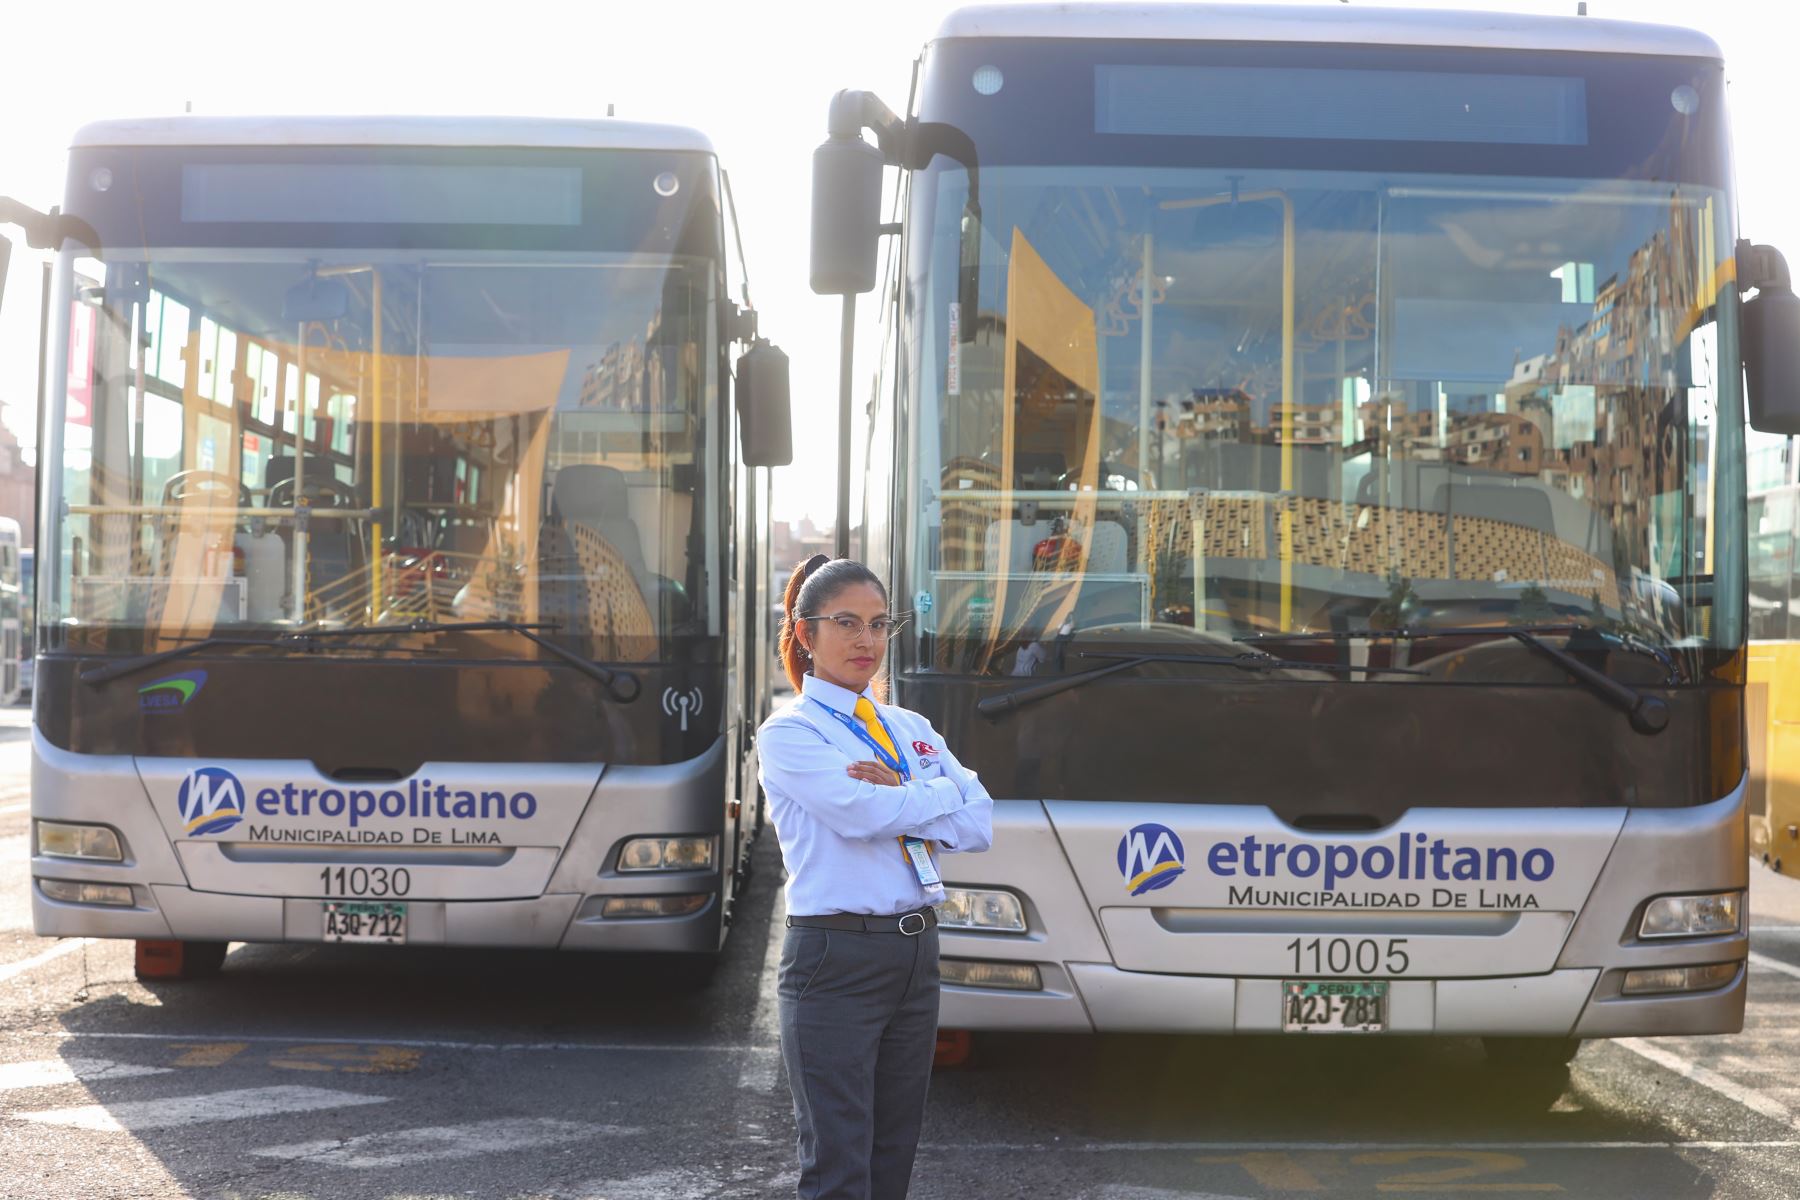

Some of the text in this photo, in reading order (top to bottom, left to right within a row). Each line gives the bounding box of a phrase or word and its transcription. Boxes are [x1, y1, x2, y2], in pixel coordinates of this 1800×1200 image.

[249, 825, 502, 845] MUNICIPALIDAD DE LIMA
[320, 866, 411, 897] 11030
[1227, 885, 1541, 909] MUNICIPALIDAD DE LIMA
[326, 912, 403, 937] A3Q-712
[1285, 937, 1411, 975] 11005
[1318, 984, 1355, 994] PERU
[1288, 995, 1383, 1025] A2J-781
